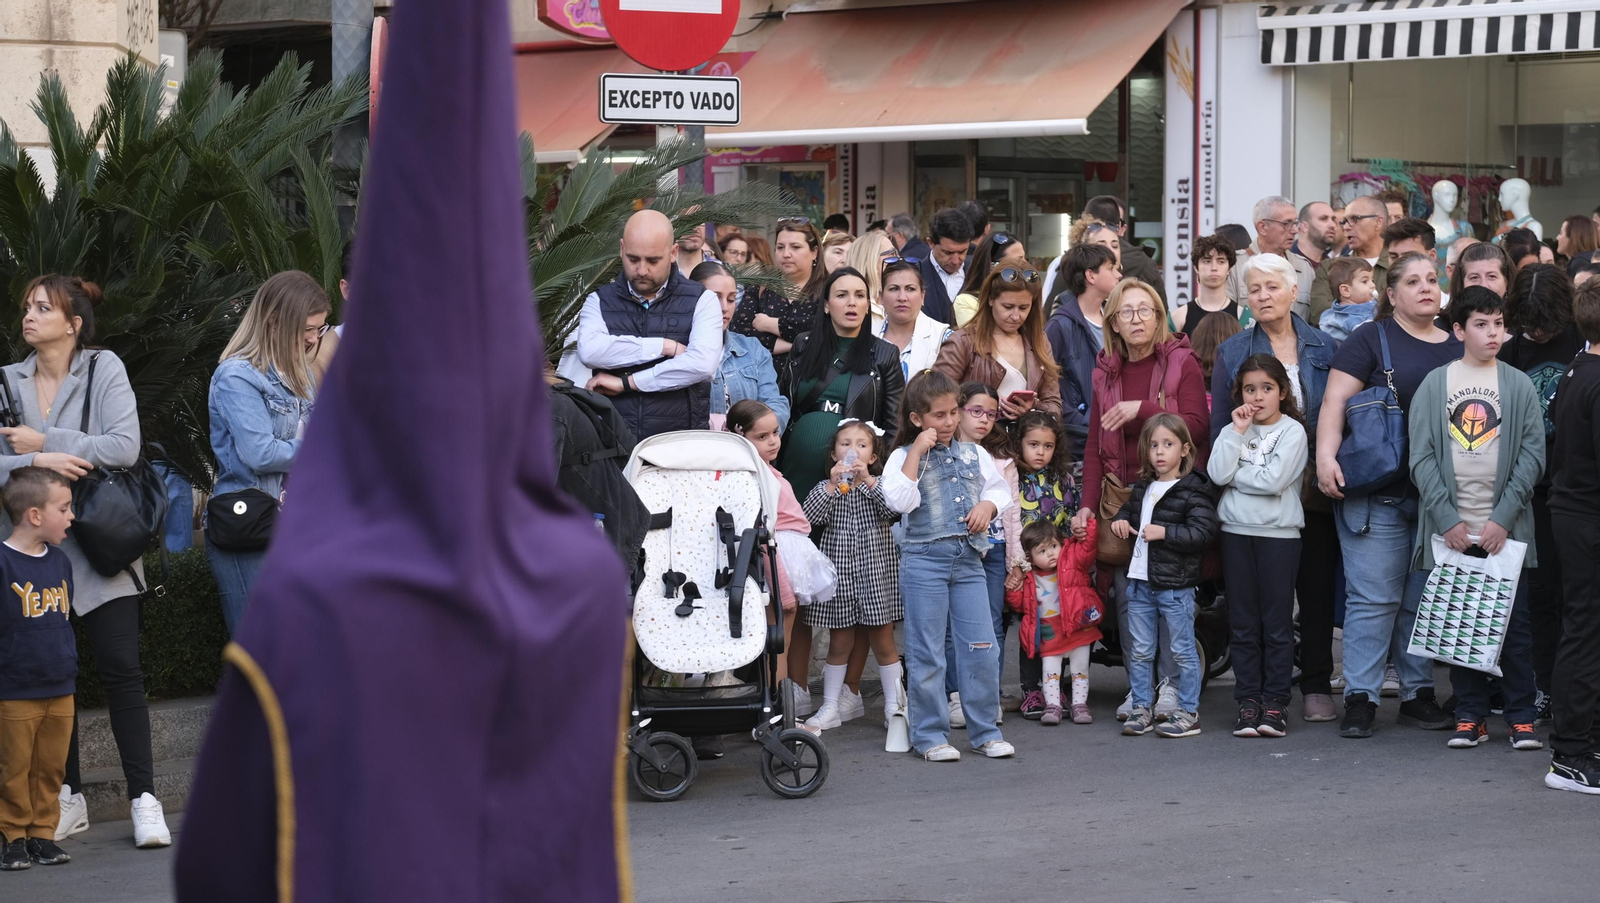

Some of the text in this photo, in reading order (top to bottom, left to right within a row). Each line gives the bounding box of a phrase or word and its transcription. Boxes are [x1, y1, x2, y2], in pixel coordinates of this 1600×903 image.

[607, 89, 735, 111] EXCEPTO VADO
[1200, 100, 1215, 209] panadería
[824, 399, 840, 414] M
[1451, 427, 1469, 448] BOUNTY
[1472, 431, 1494, 449] HUNTER
[11, 579, 70, 621] YEAH!
